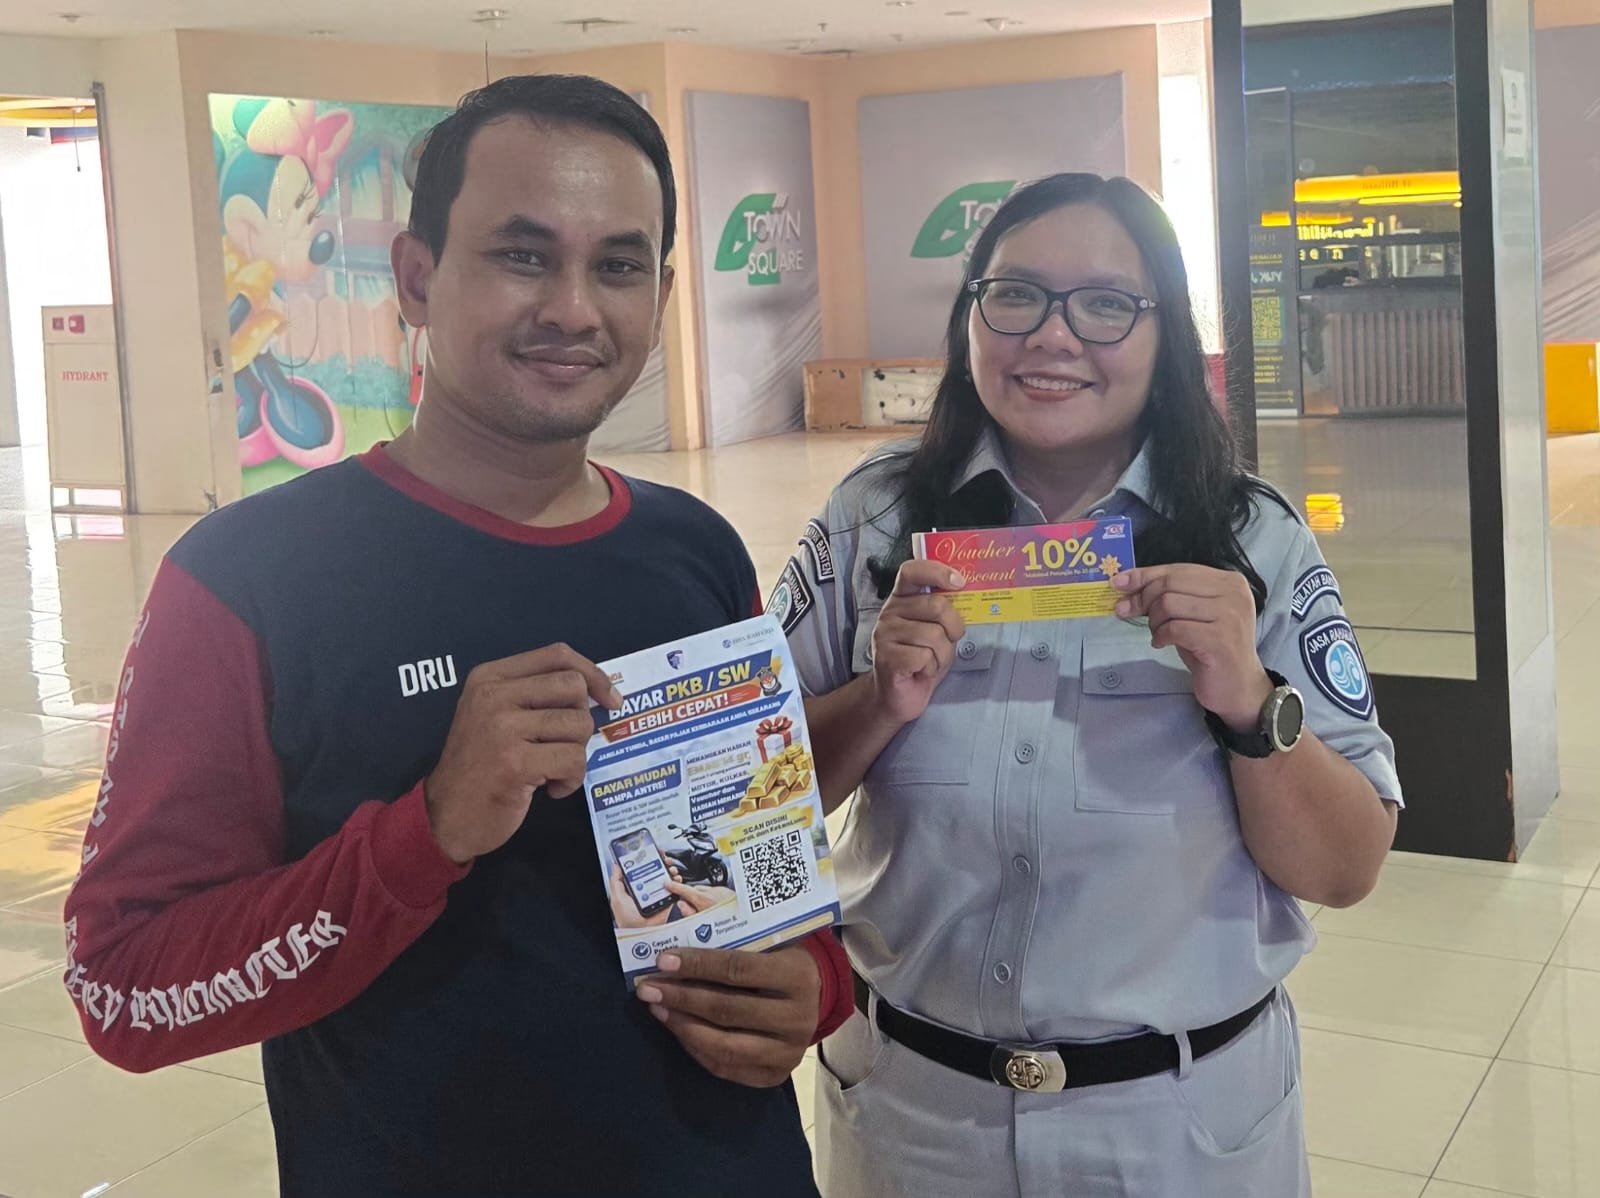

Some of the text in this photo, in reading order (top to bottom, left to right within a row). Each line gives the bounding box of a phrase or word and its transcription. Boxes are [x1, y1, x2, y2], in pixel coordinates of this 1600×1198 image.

[743, 208, 801, 242] TOWN
[748, 249, 804, 275] SQUARE
[62, 371, 109, 382] HYDRANT
[815, 540, 833, 577] BANTEN
[935, 534, 1016, 562] Voucher
[1021, 537, 1097, 570] 10%
[1292, 575, 1321, 609] WILAYAH
[1309, 631, 1331, 654] JASA
[398, 654, 458, 697] DRU
[608, 660, 751, 721] BAYAR PKB / SW
[629, 692, 729, 734] LEBIH CEPAT!
[594, 764, 677, 798] BAYAR MUDAH
[602, 779, 667, 806] TANPA ANTRE!
[743, 823, 765, 835] SCAN
